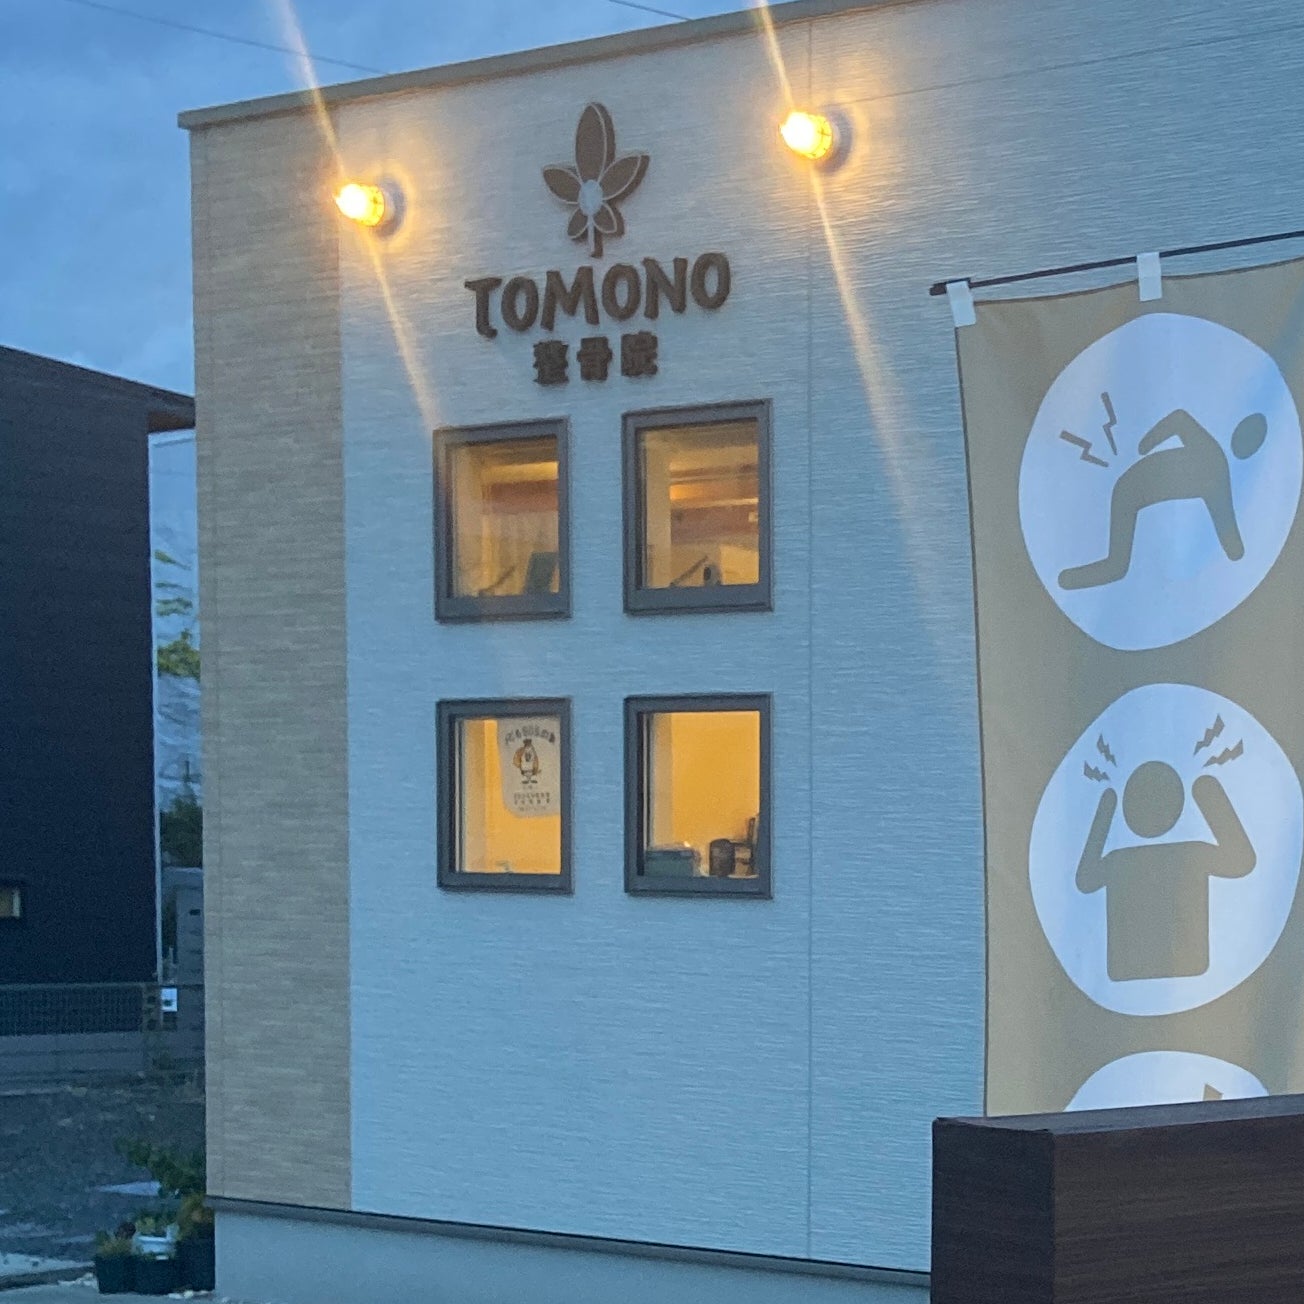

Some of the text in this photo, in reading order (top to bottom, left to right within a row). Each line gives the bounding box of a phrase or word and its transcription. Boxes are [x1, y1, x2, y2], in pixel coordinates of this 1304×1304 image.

[464, 251, 732, 339] TOMONO
[532, 331, 660, 386] 整骨院
